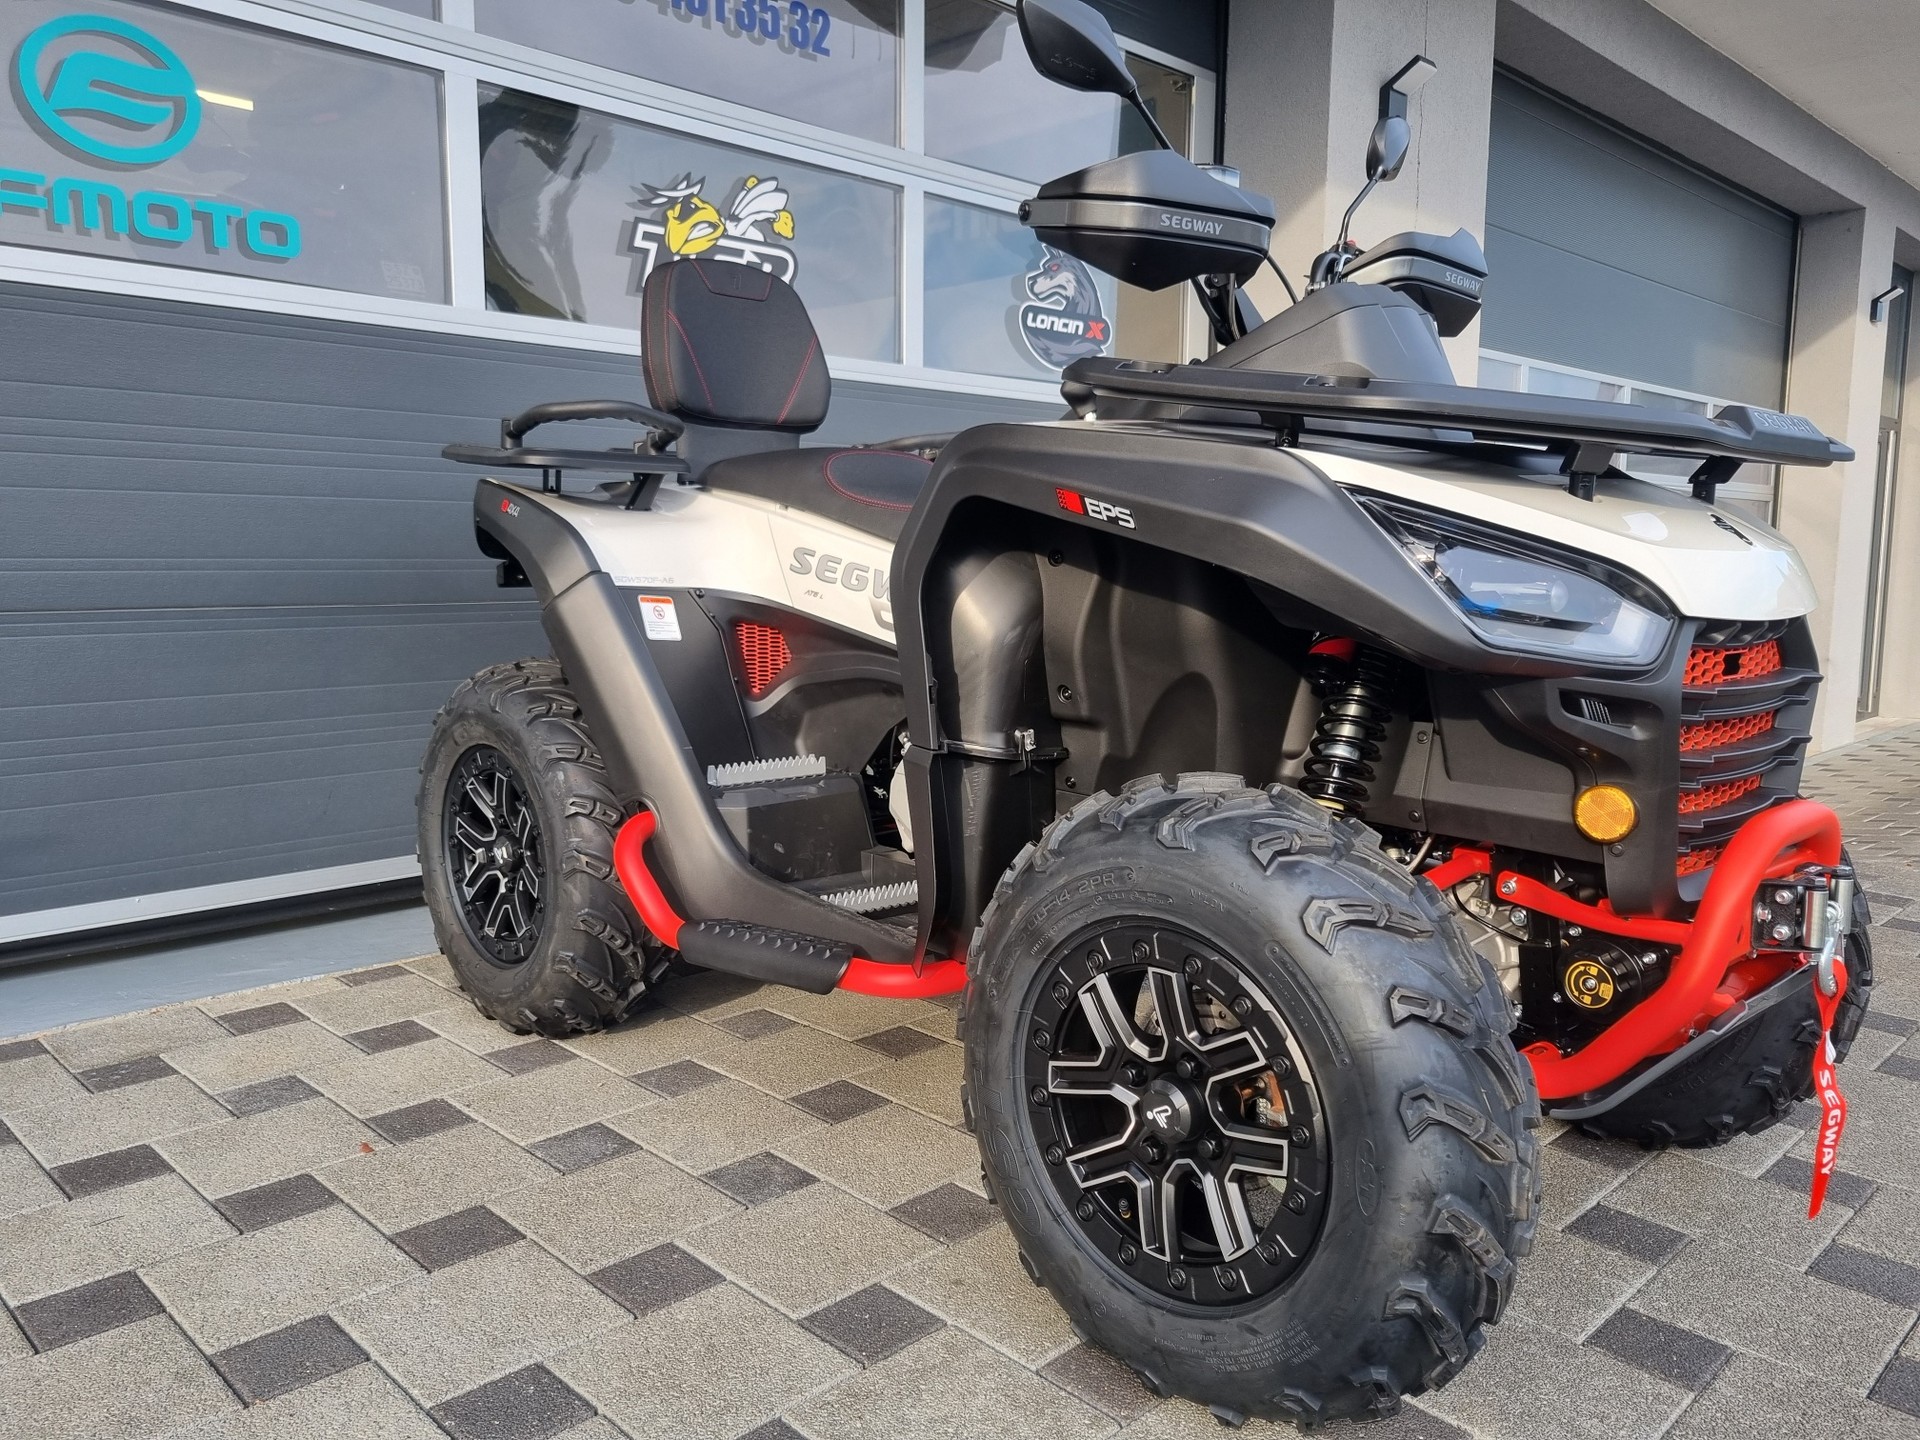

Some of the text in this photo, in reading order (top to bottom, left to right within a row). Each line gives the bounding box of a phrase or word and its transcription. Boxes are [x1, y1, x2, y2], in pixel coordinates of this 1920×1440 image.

[735, 0, 781, 40] 35
[789, 1, 831, 57] 32
[1160, 213, 1223, 235] SEGWAY
[1445, 271, 1481, 291] SEGWAY
[1026, 312, 1105, 340] LONCIN X
[1753, 410, 1815, 434] SEGWAY
[1084, 497, 1135, 529] EPS
[1078, 872, 1116, 894] 2PR
[1820, 1070, 1842, 1174] SEGWAY
